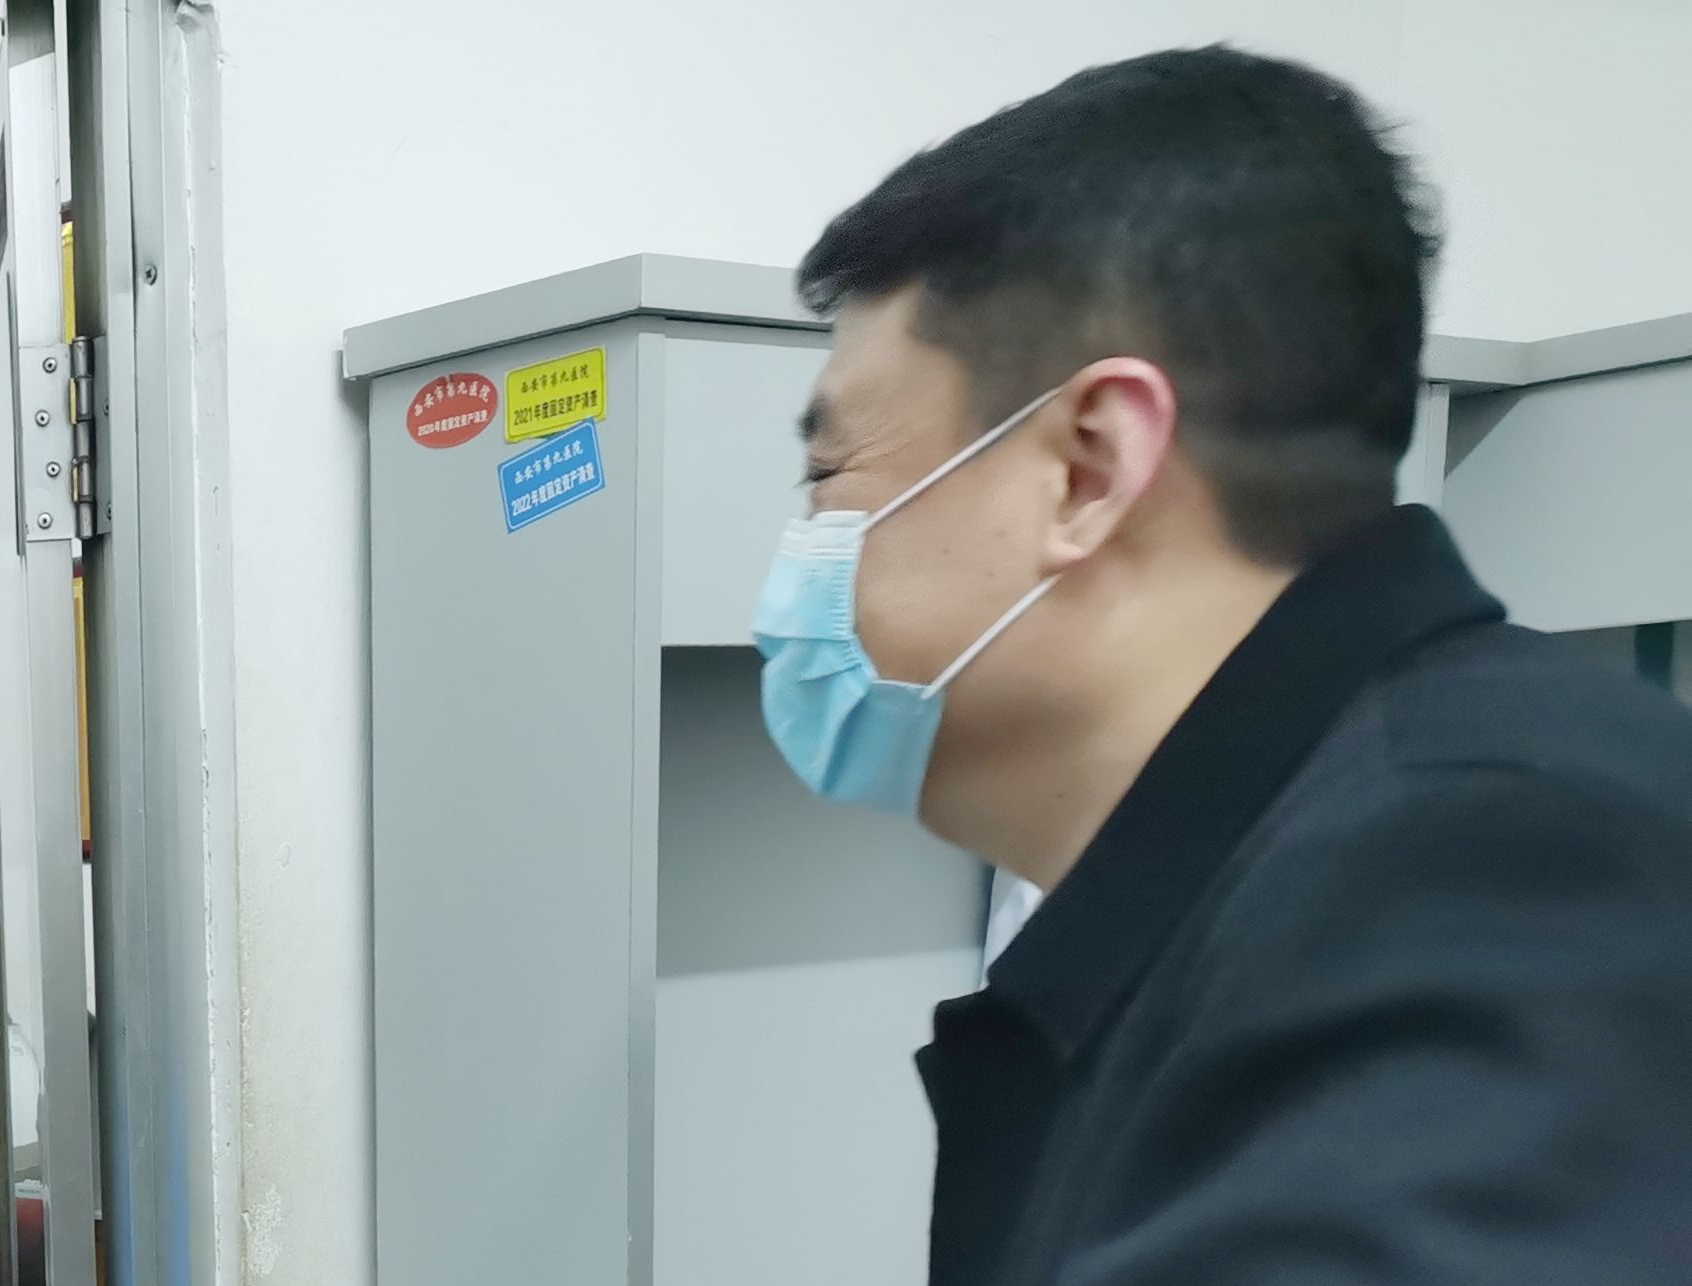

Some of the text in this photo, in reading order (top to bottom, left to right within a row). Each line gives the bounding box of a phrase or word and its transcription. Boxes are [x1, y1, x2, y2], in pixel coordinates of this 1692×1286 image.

[520, 363, 590, 394] 西安市第九医院
[514, 390, 597, 426] 2021年度固定资产清查
[514, 440, 584, 485] 西安市第九医院
[510, 461, 596, 517] 2022年度固定资产清查
